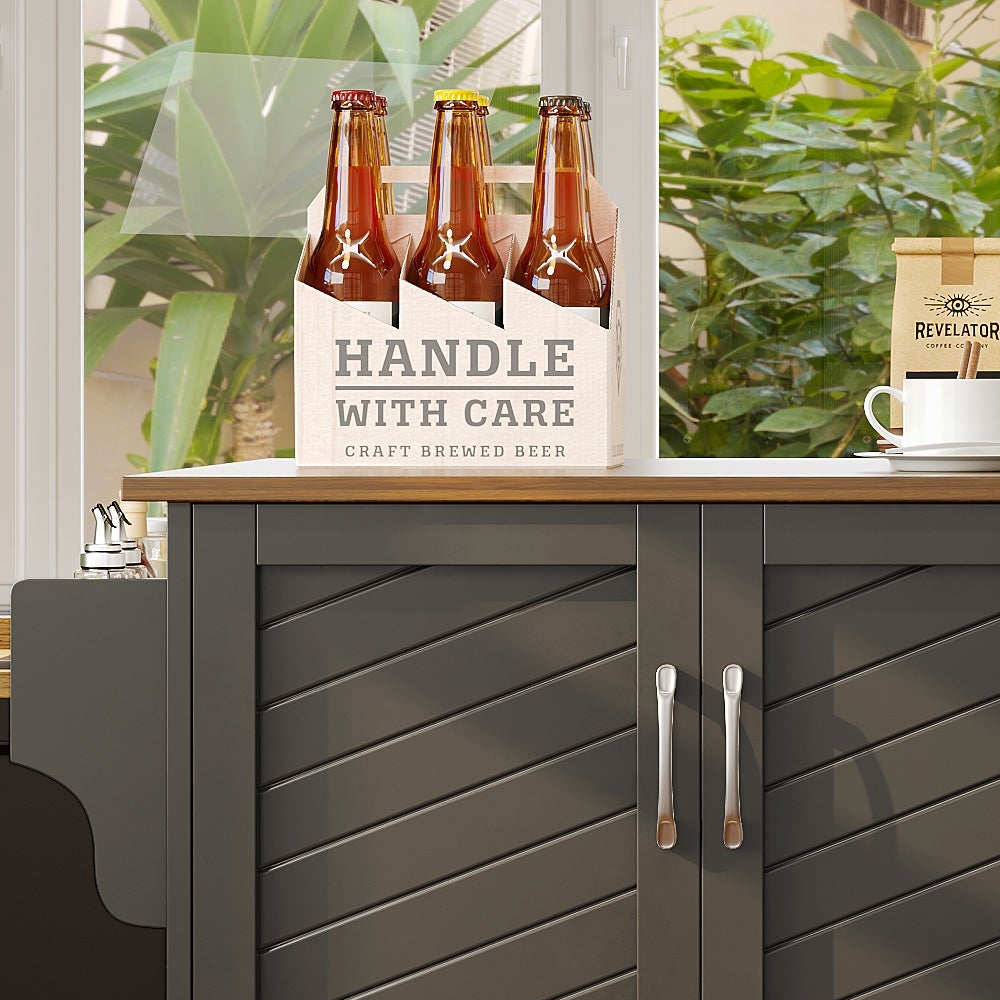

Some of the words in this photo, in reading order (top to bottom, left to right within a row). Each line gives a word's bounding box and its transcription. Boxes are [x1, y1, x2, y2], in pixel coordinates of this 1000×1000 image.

[915, 321, 1000, 340] REVELATOR
[335, 339, 574, 377] HANDLE
[336, 399, 448, 427] WITH
[464, 399, 575, 427] CARE
[345, 445, 412, 458] CRAFT
[421, 445, 506, 458] BREWED
[514, 445, 567, 458] BEER
